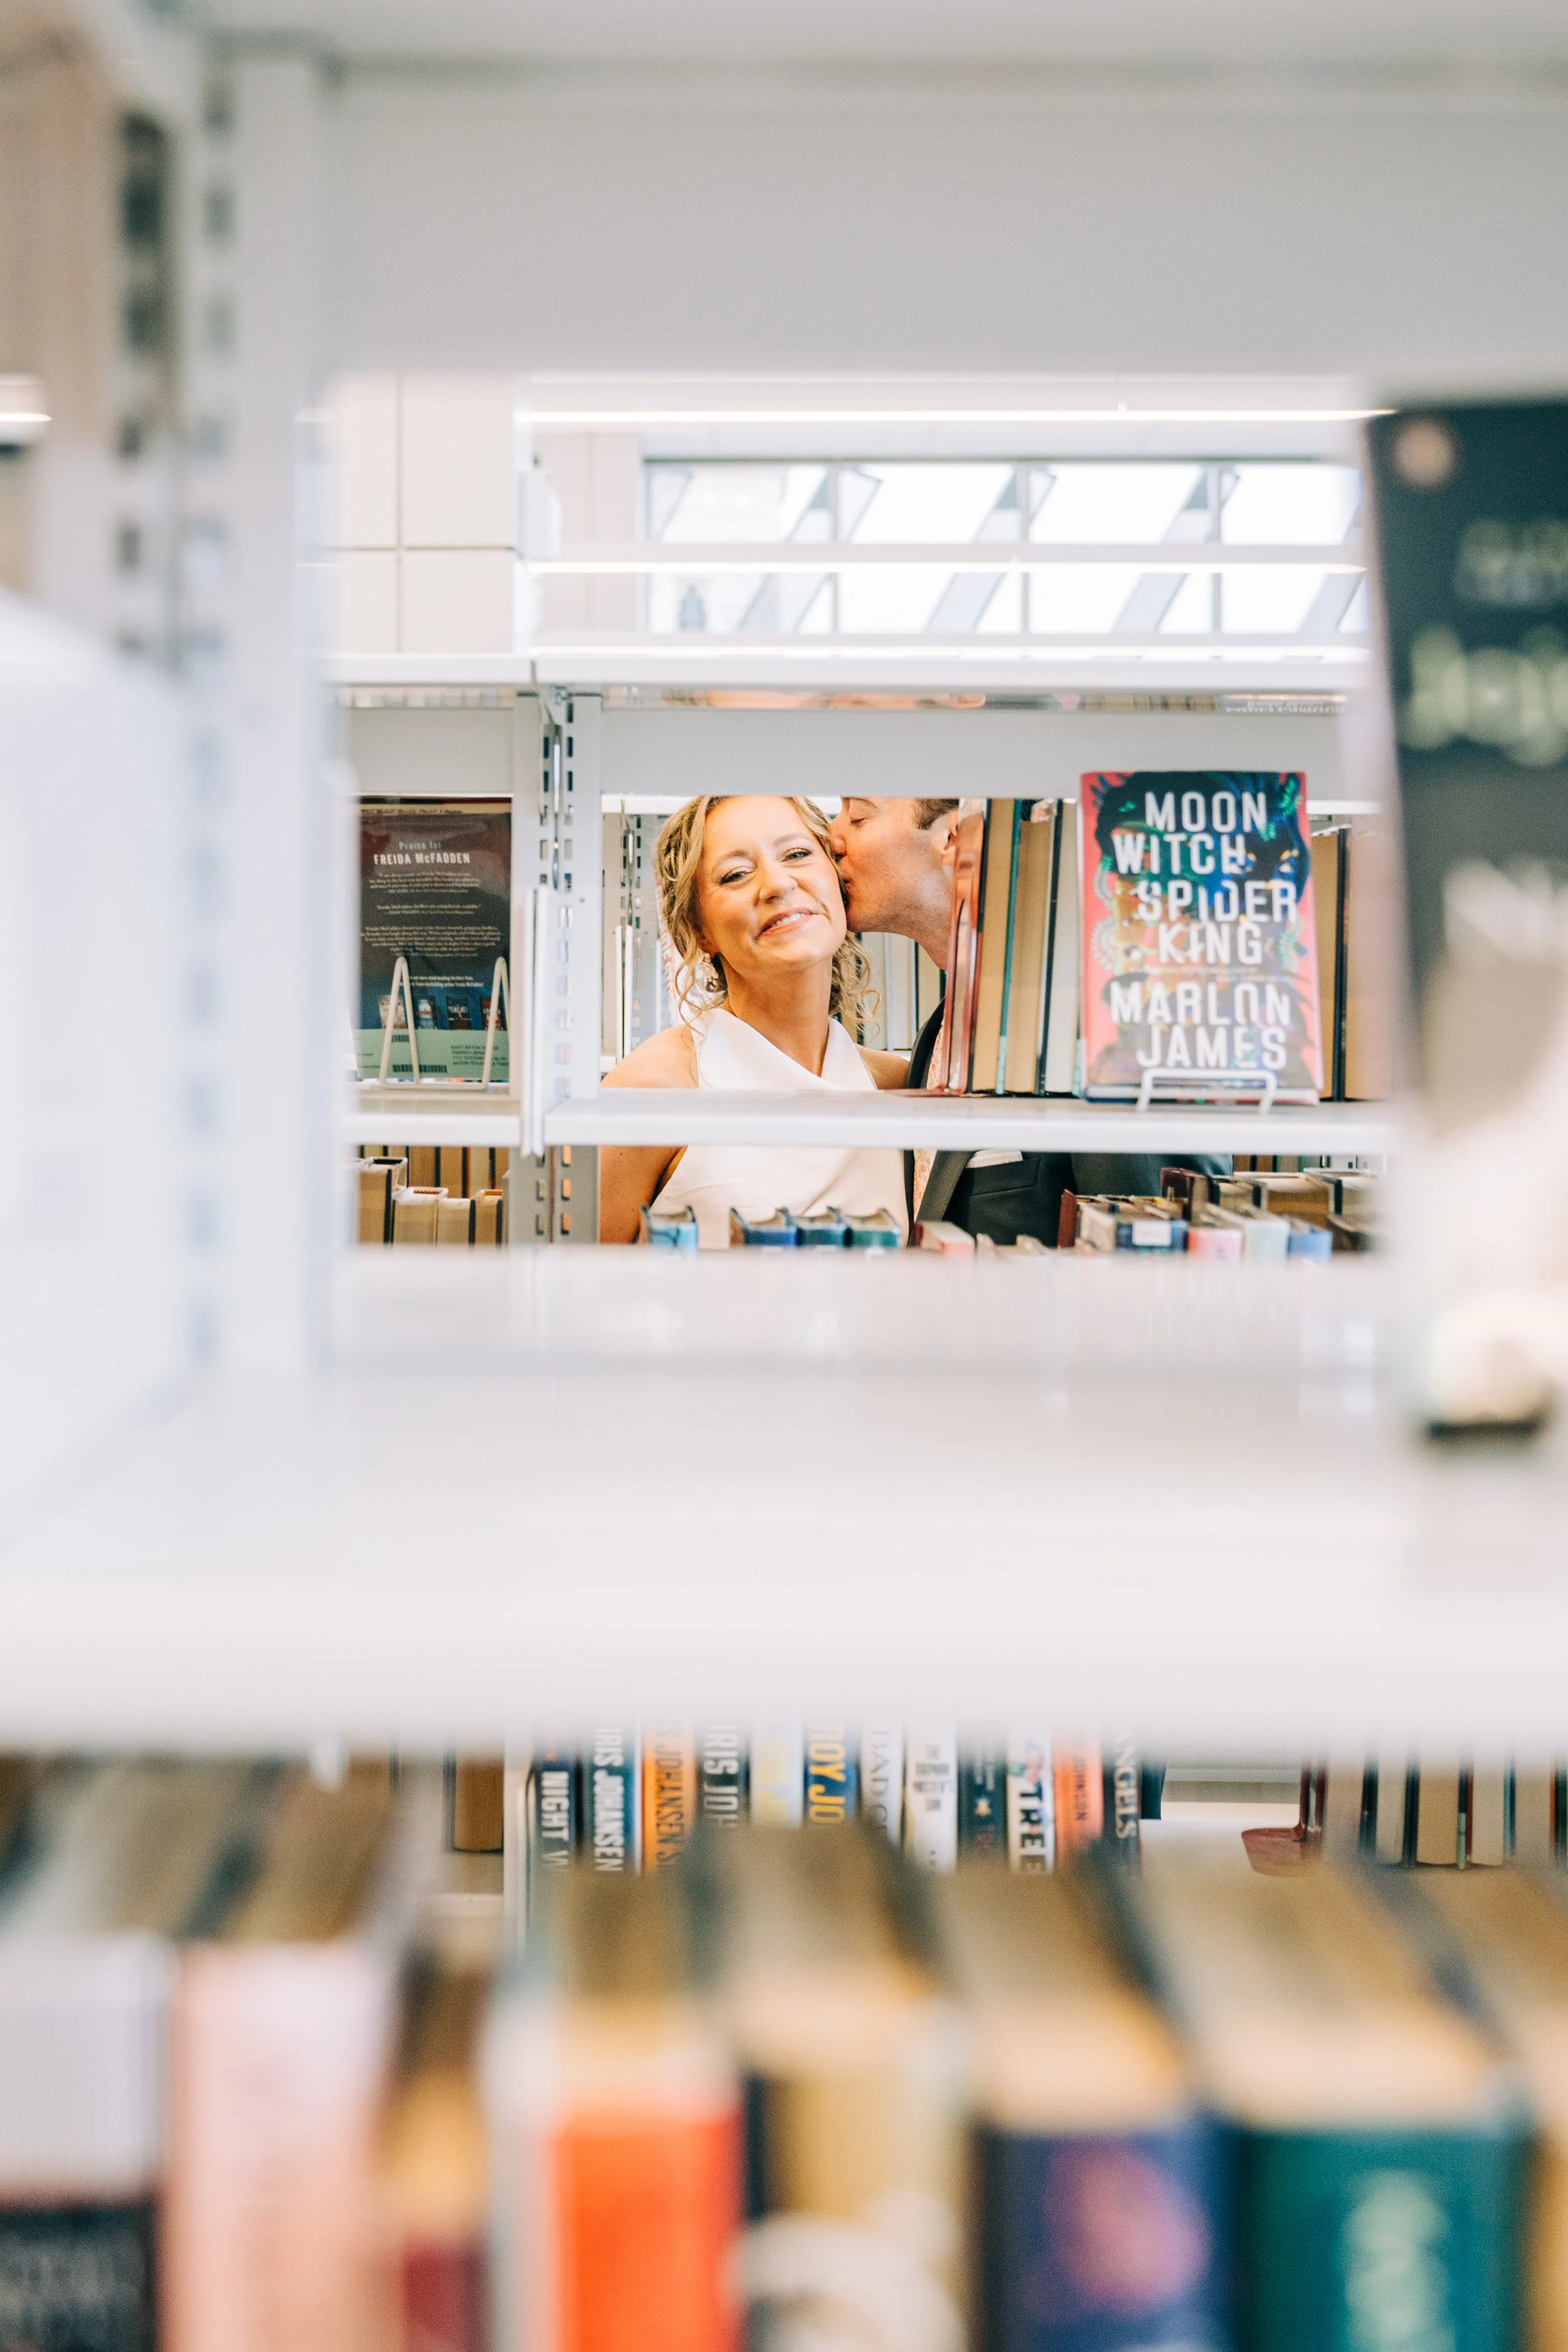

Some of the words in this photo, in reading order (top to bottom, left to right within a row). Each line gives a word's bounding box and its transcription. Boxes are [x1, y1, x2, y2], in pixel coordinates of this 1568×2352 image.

[1145, 792, 1268, 833] MOON
[374, 853, 411, 865] FREIDA
[415, 852, 470, 864] McFADDEN
[1113, 834, 1246, 874] WITCH
[1136, 880, 1297, 922] SPIDER
[1158, 923, 1263, 965] KING
[1110, 982, 1291, 1025] MARLON
[1136, 1026, 1287, 1070] JAMES
[593, 1727, 624, 1767] IRIS
[704, 1724, 739, 1774] IRIS
[808, 1723, 847, 1782] ROY
[541, 1771, 569, 1841] NIGHT
[654, 1744, 685, 1844] JOHANSEN
[593, 1769, 625, 1872] JOHANSEN
[1019, 1782, 1046, 1873] TREE
